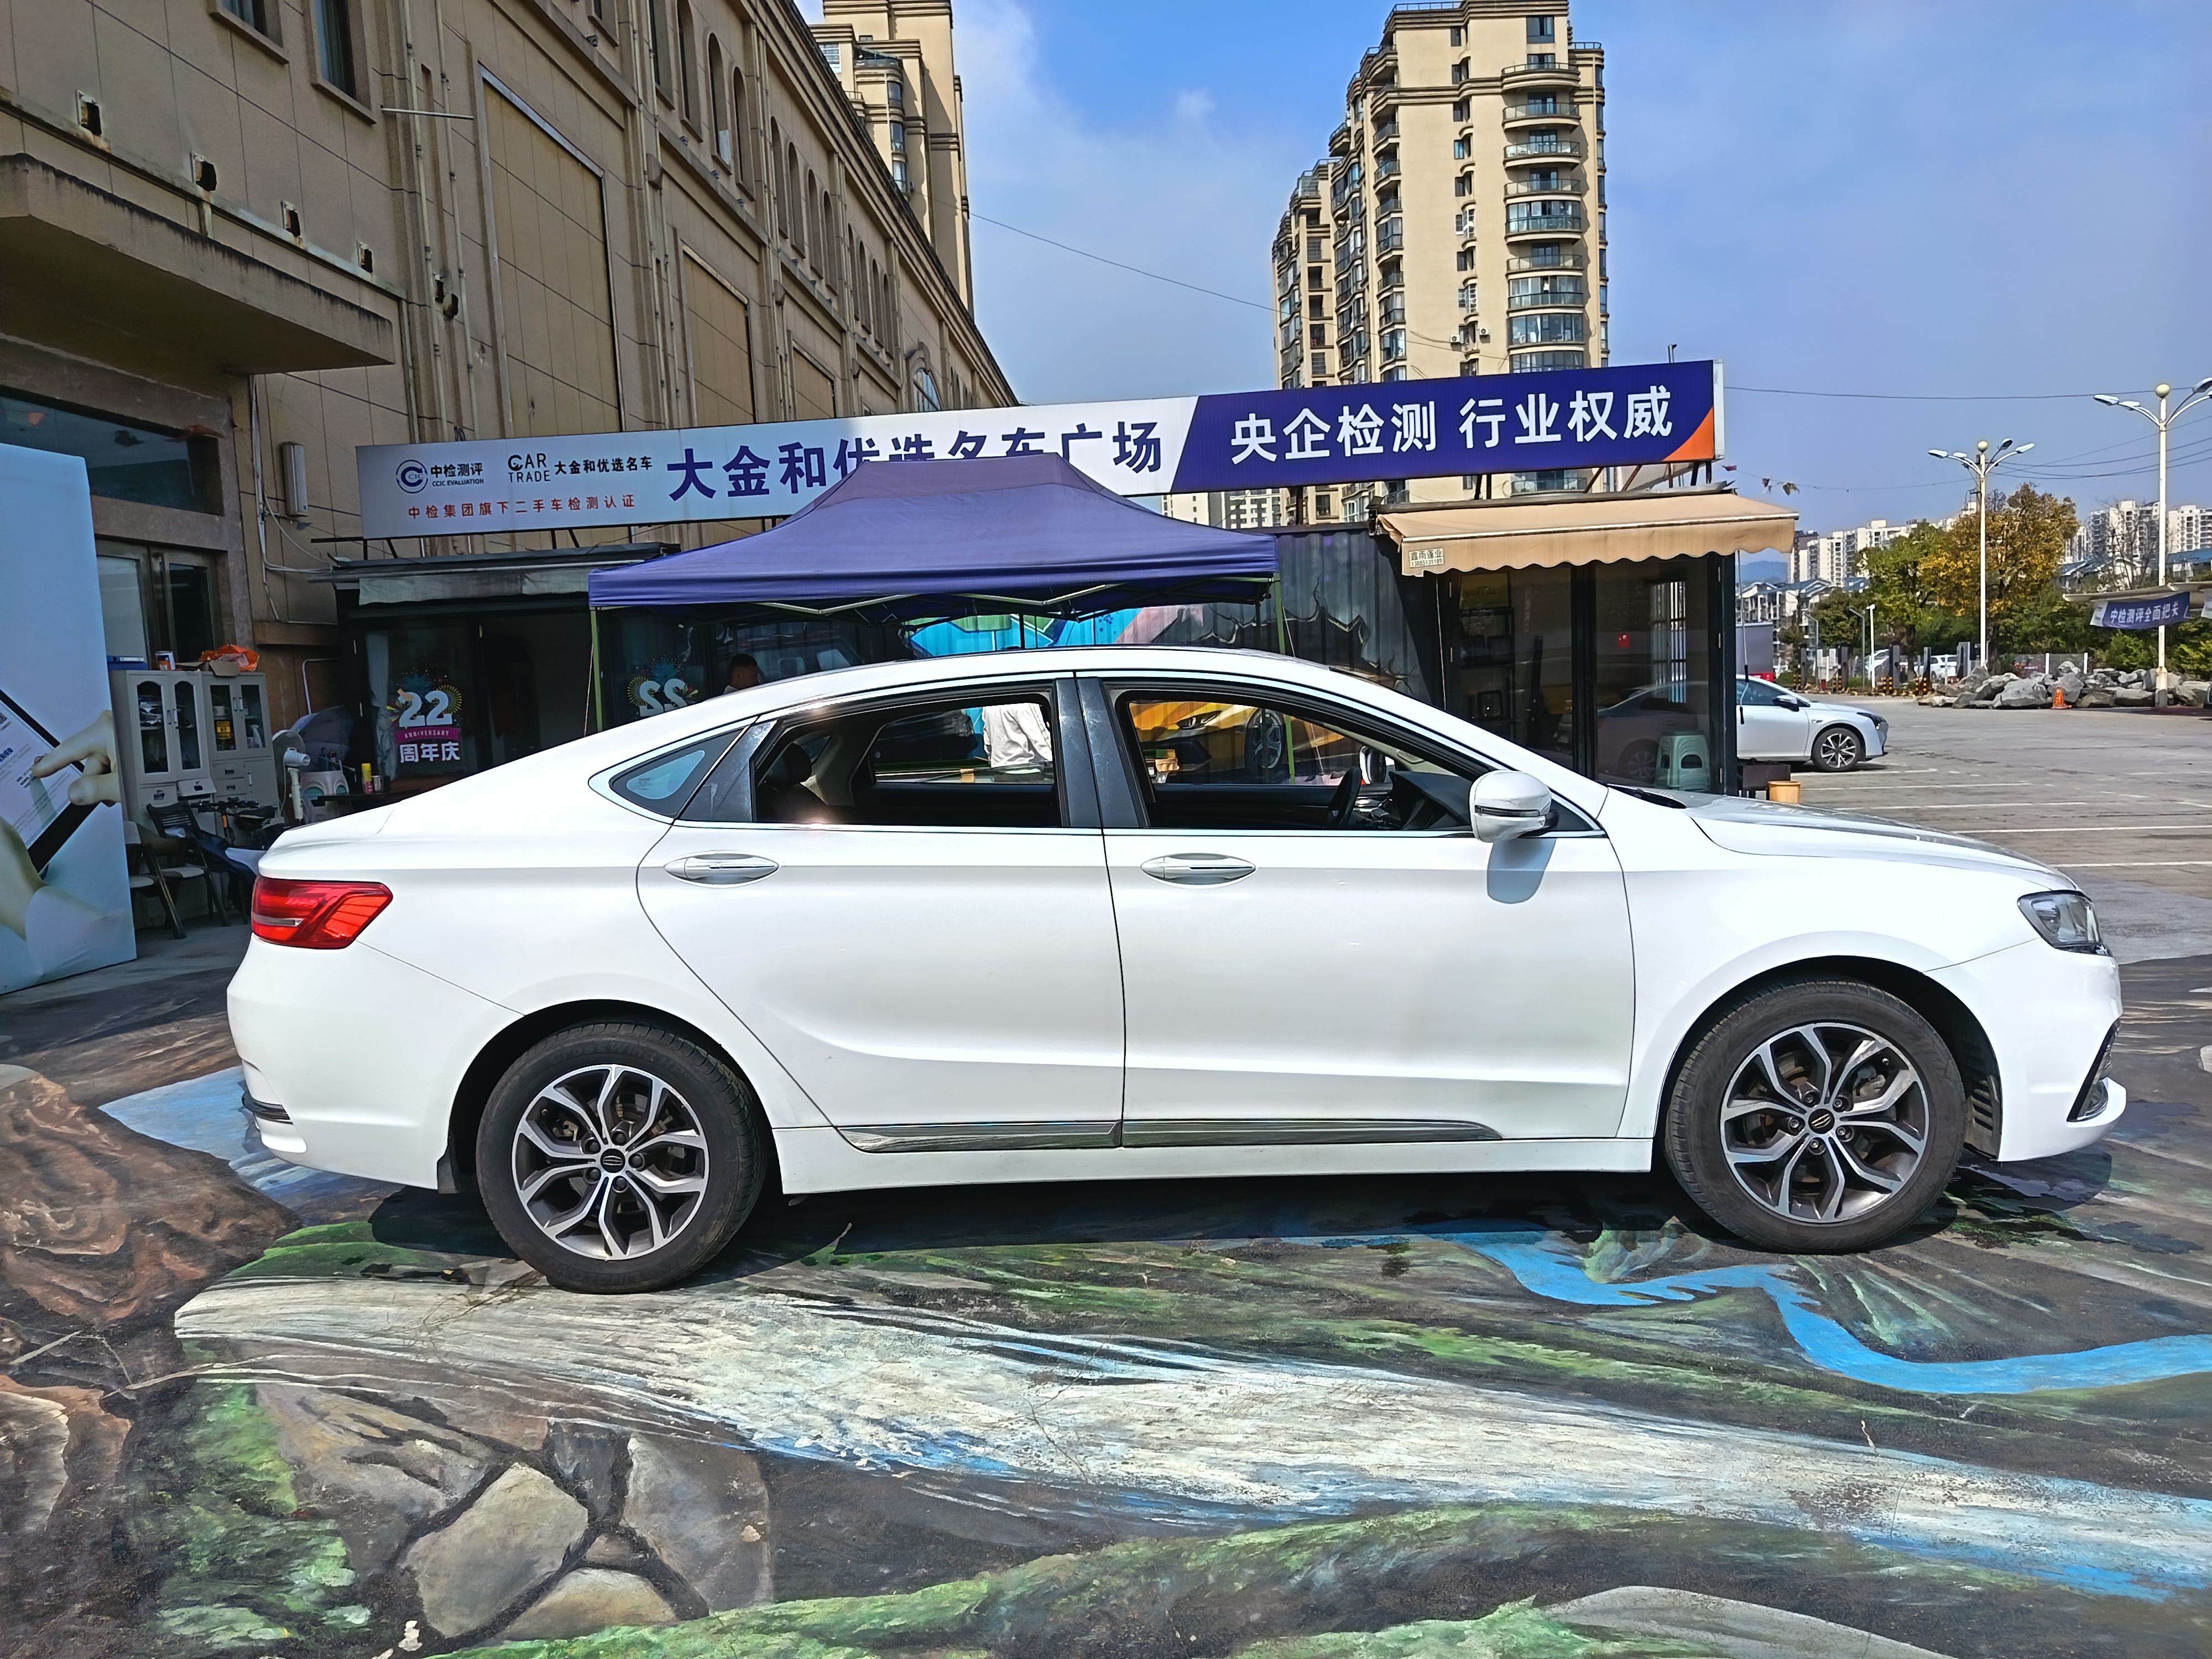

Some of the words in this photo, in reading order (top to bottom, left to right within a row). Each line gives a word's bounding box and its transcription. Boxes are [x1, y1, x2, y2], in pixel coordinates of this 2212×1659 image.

[1230, 400, 1436, 465] 央企检测
[1459, 385, 1672, 449] 行业权威
[430, 462, 483, 478] 中检测评
[507, 453, 547, 471] CAR
[554, 456, 653, 475] 大金和优选名车
[508, 470, 552, 483] TRADE
[408, 494, 635, 520] 中检集团旗下二手车检测认证
[2110, 601, 2179, 623] 中检测评全面把关
[398, 690, 453, 728] 22
[404, 729, 450, 739] ANNIVERSARY
[400, 742, 460, 763] 周年庆
